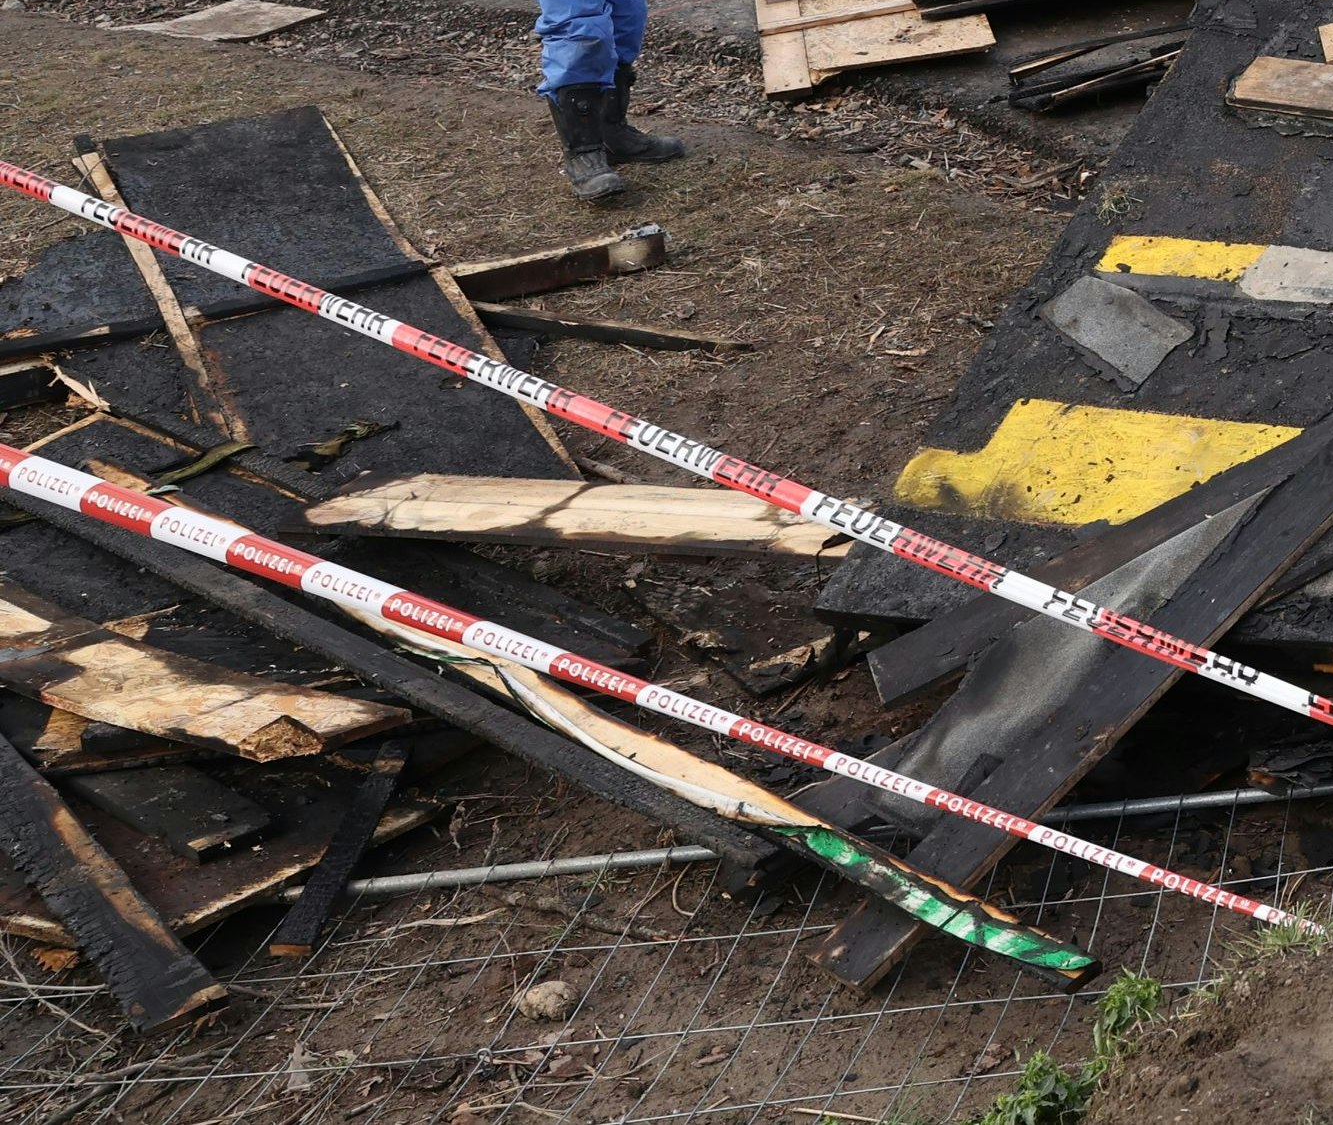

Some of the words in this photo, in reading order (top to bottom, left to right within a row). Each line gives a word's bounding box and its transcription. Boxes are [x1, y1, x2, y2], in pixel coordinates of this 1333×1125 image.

[81, 197, 213, 267] FEUERWEHR
[241, 262, 392, 336] FEUERWEHR
[414, 334, 575, 413] FEUERWEHR
[603, 410, 779, 497] FEUERWEHR
[811, 496, 1010, 591] FEUERWEHR
[17, 465, 75, 497] POLIZEI
[86, 491, 145, 523] POLIZEI
[160, 517, 218, 550] POLIZEI
[232, 543, 294, 577] POLIZEI
[310, 569, 373, 603] POLIZEI
[389, 599, 456, 635] POLIZEI
[472, 625, 542, 662] POLIZEI
[557, 656, 628, 692] POLIZEI
[646, 687, 719, 727] POLIZEI
[738, 722, 813, 760] POLIZEI
[833, 756, 911, 794] POLIZEI
[936, 790, 1014, 830] POLIZEI
[1037, 828, 1122, 870] POLIZEI
[1149, 867, 1236, 910] POLIZEI
